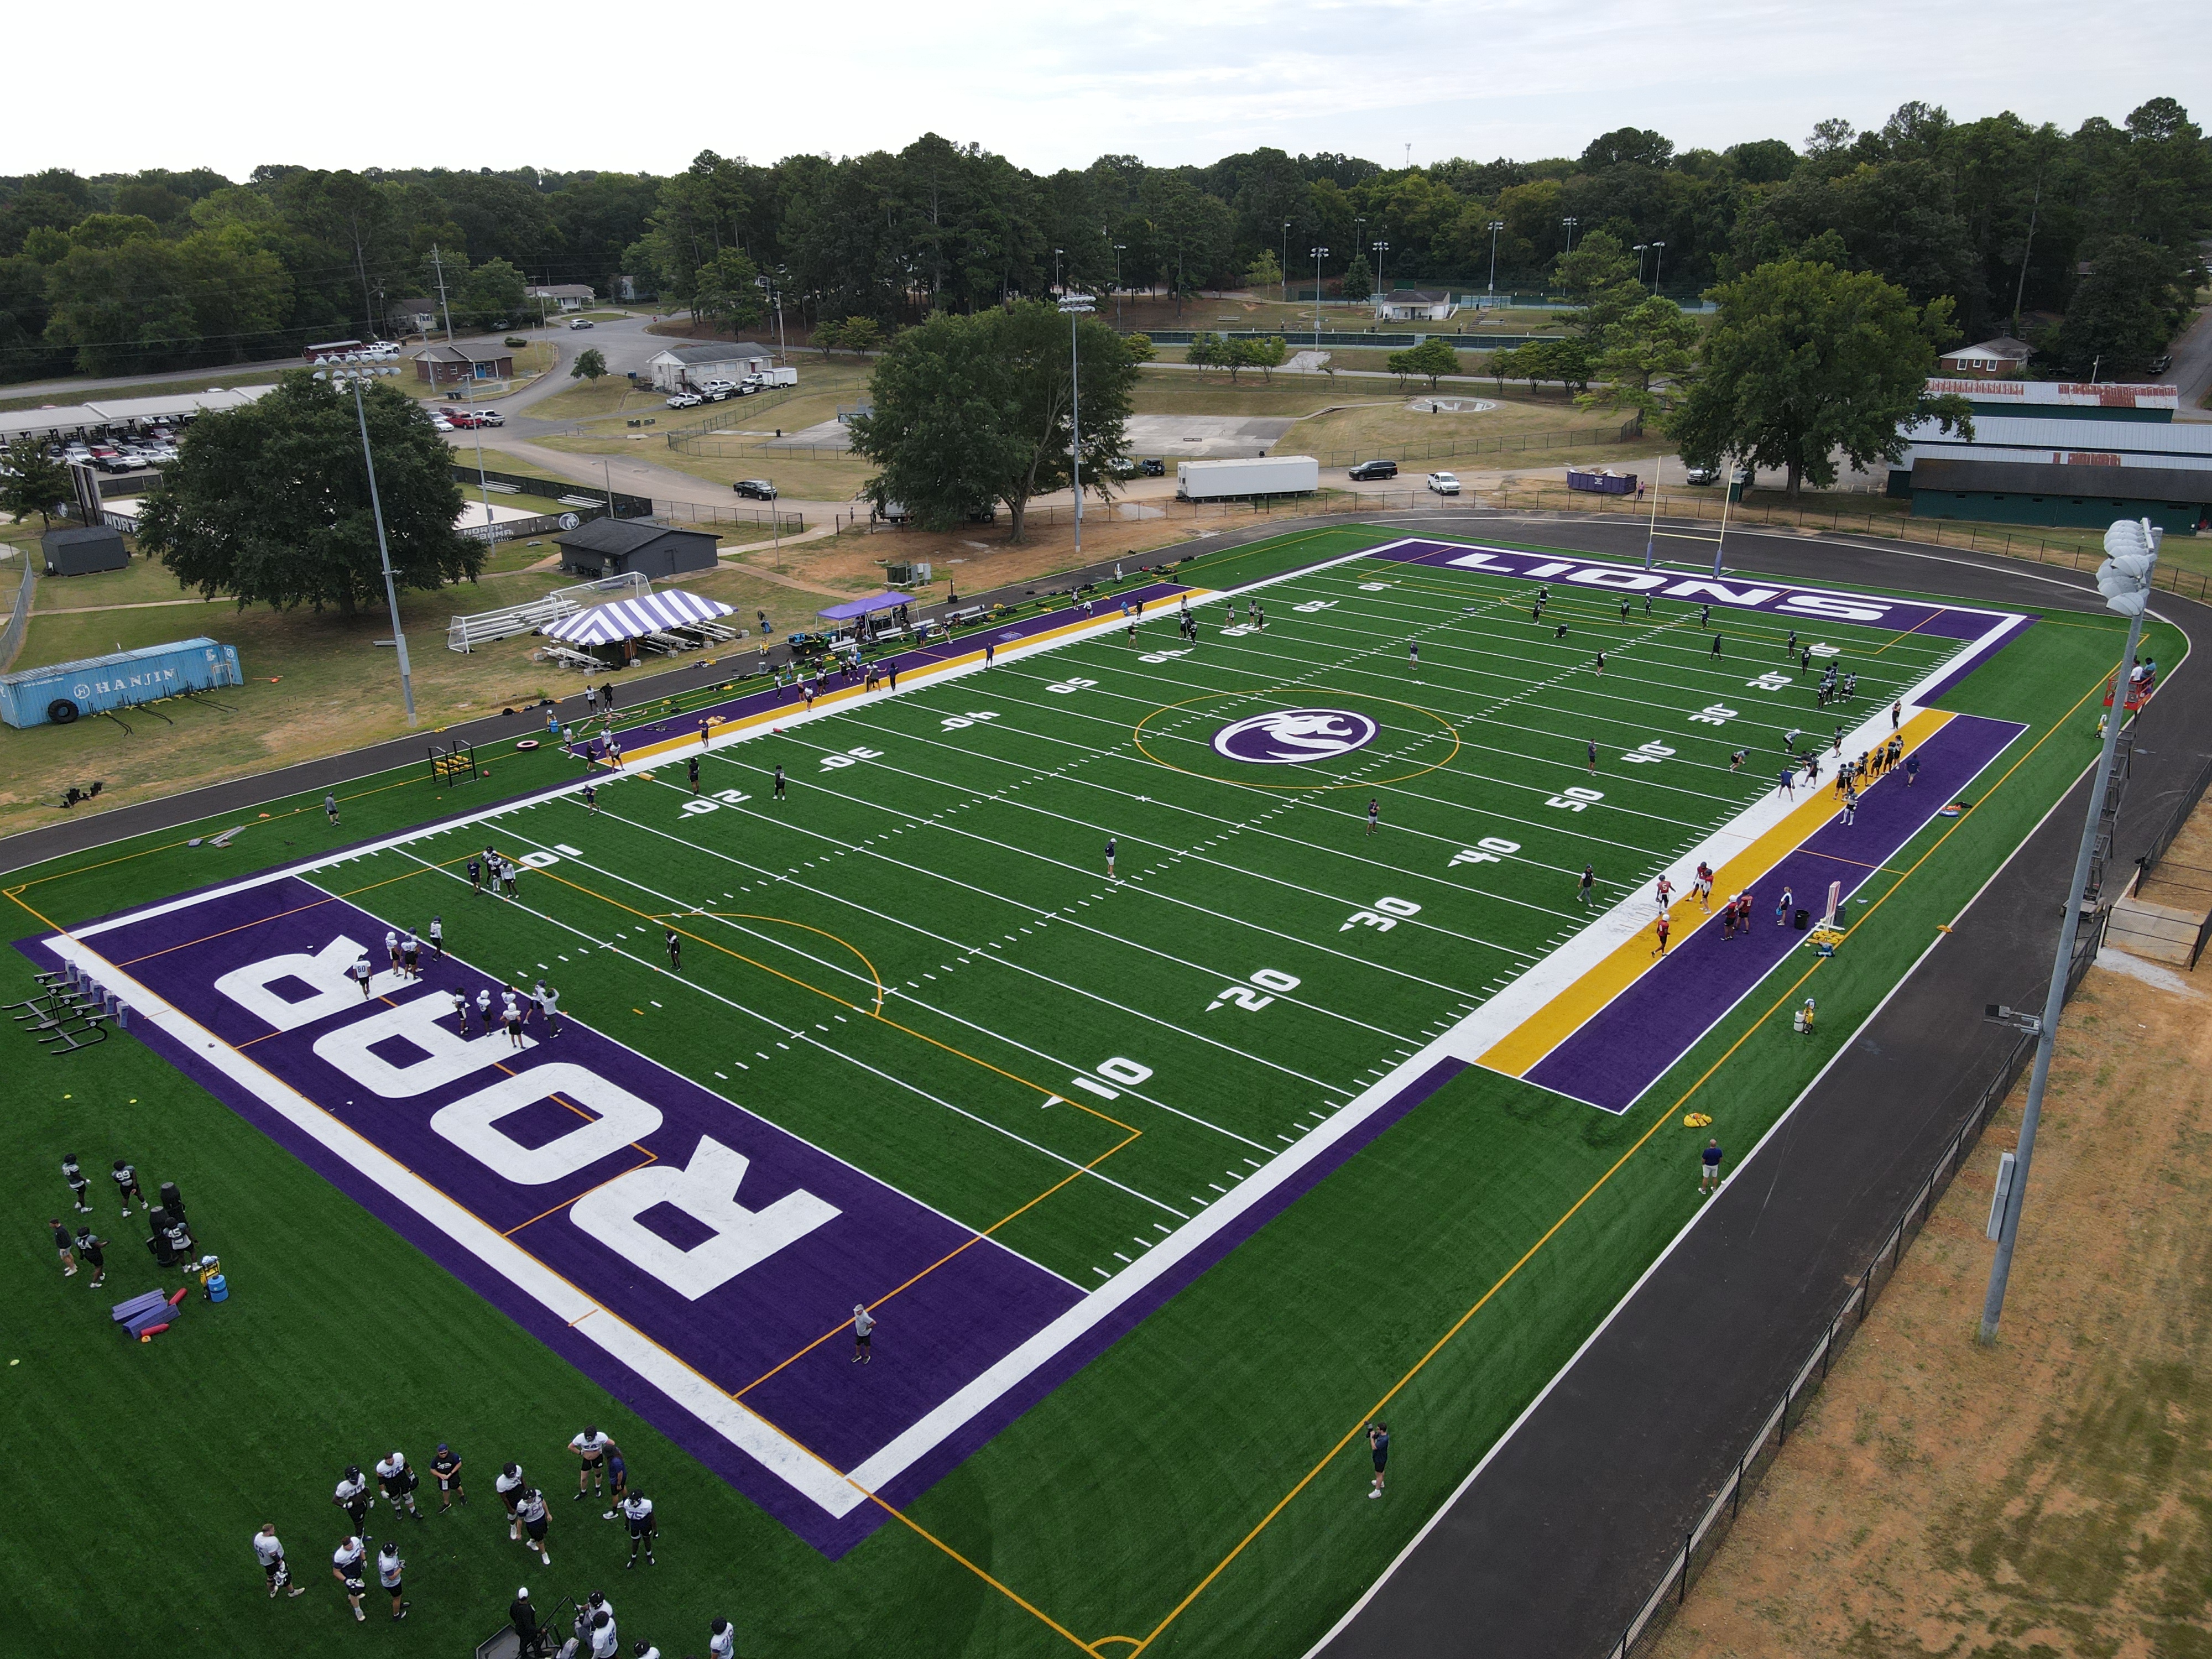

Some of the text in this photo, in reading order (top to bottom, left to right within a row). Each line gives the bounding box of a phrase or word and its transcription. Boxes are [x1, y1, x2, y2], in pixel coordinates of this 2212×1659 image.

[1446, 553, 1892, 620] LIONS
[1292, 601, 1334, 612] 20
[1138, 650, 1188, 664] 40
[95, 667, 175, 694] HANJIN
[1045, 677, 1099, 694] 50
[1746, 674, 1793, 691] 20
[941, 712, 1001, 728] 40
[1687, 707, 1738, 726] 30
[820, 747, 885, 768] 30
[1620, 744, 1676, 763] 40
[682, 789, 752, 815] 20
[1544, 787, 1604, 812] 50
[519, 844, 583, 868] 10
[1453, 837, 1521, 863] 40
[1347, 896, 1422, 932] 30
[357, 964, 366, 973] 80
[1217, 969, 1301, 1012] 20
[1071, 1057, 1154, 1100] 10
[116, 1170, 131, 1181] 99
[168, 1228, 182, 1238] 45
